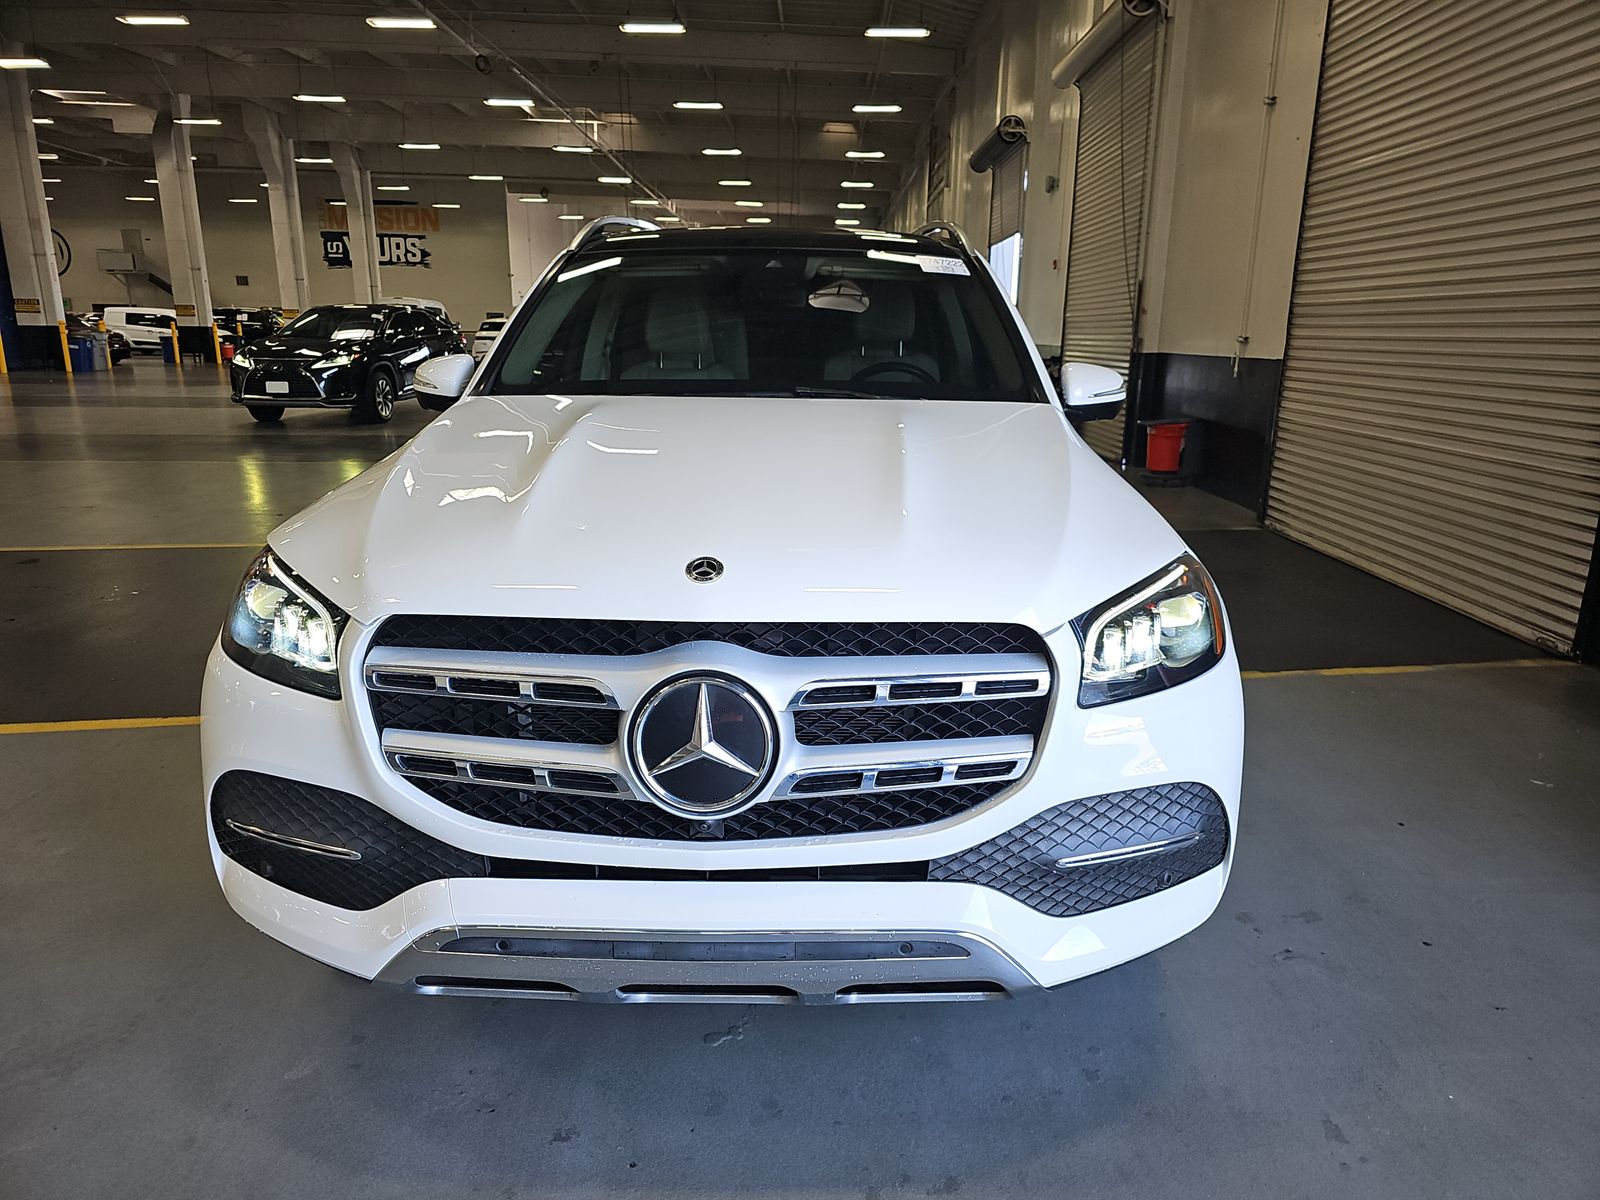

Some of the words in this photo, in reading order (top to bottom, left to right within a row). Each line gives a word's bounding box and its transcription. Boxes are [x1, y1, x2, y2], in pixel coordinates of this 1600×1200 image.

[326, 206, 440, 232] MSION
[327, 241, 344, 258] IS
[342, 235, 422, 263] YURS
